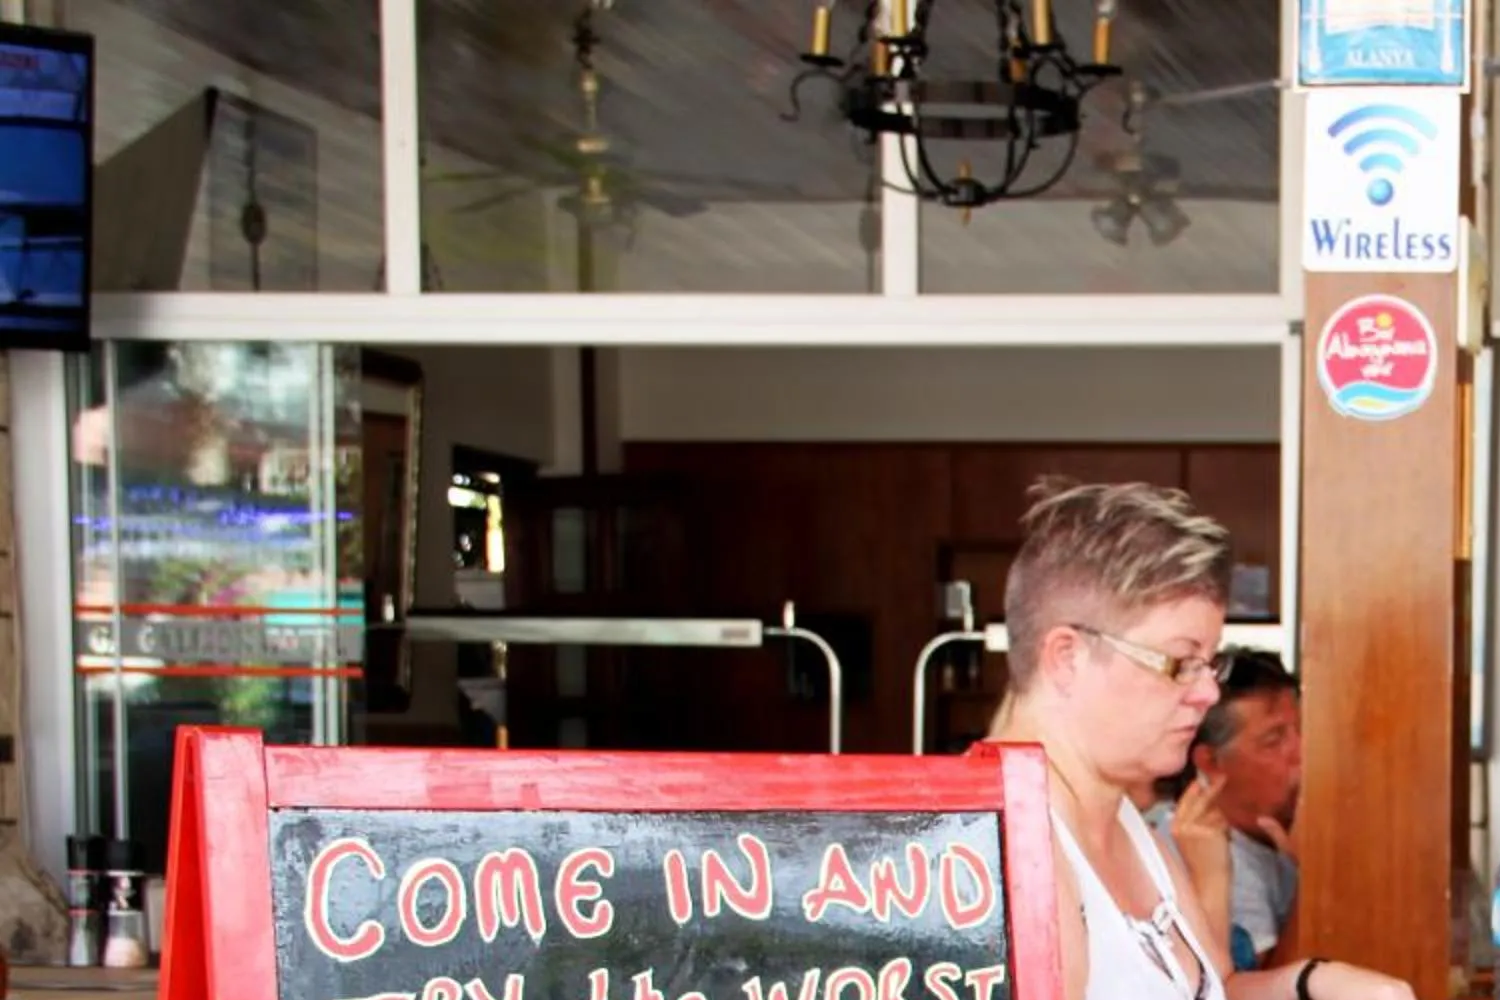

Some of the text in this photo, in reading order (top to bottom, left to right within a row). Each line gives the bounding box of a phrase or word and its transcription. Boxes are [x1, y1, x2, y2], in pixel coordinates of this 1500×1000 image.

[306, 833, 995, 962] COME IN AND
